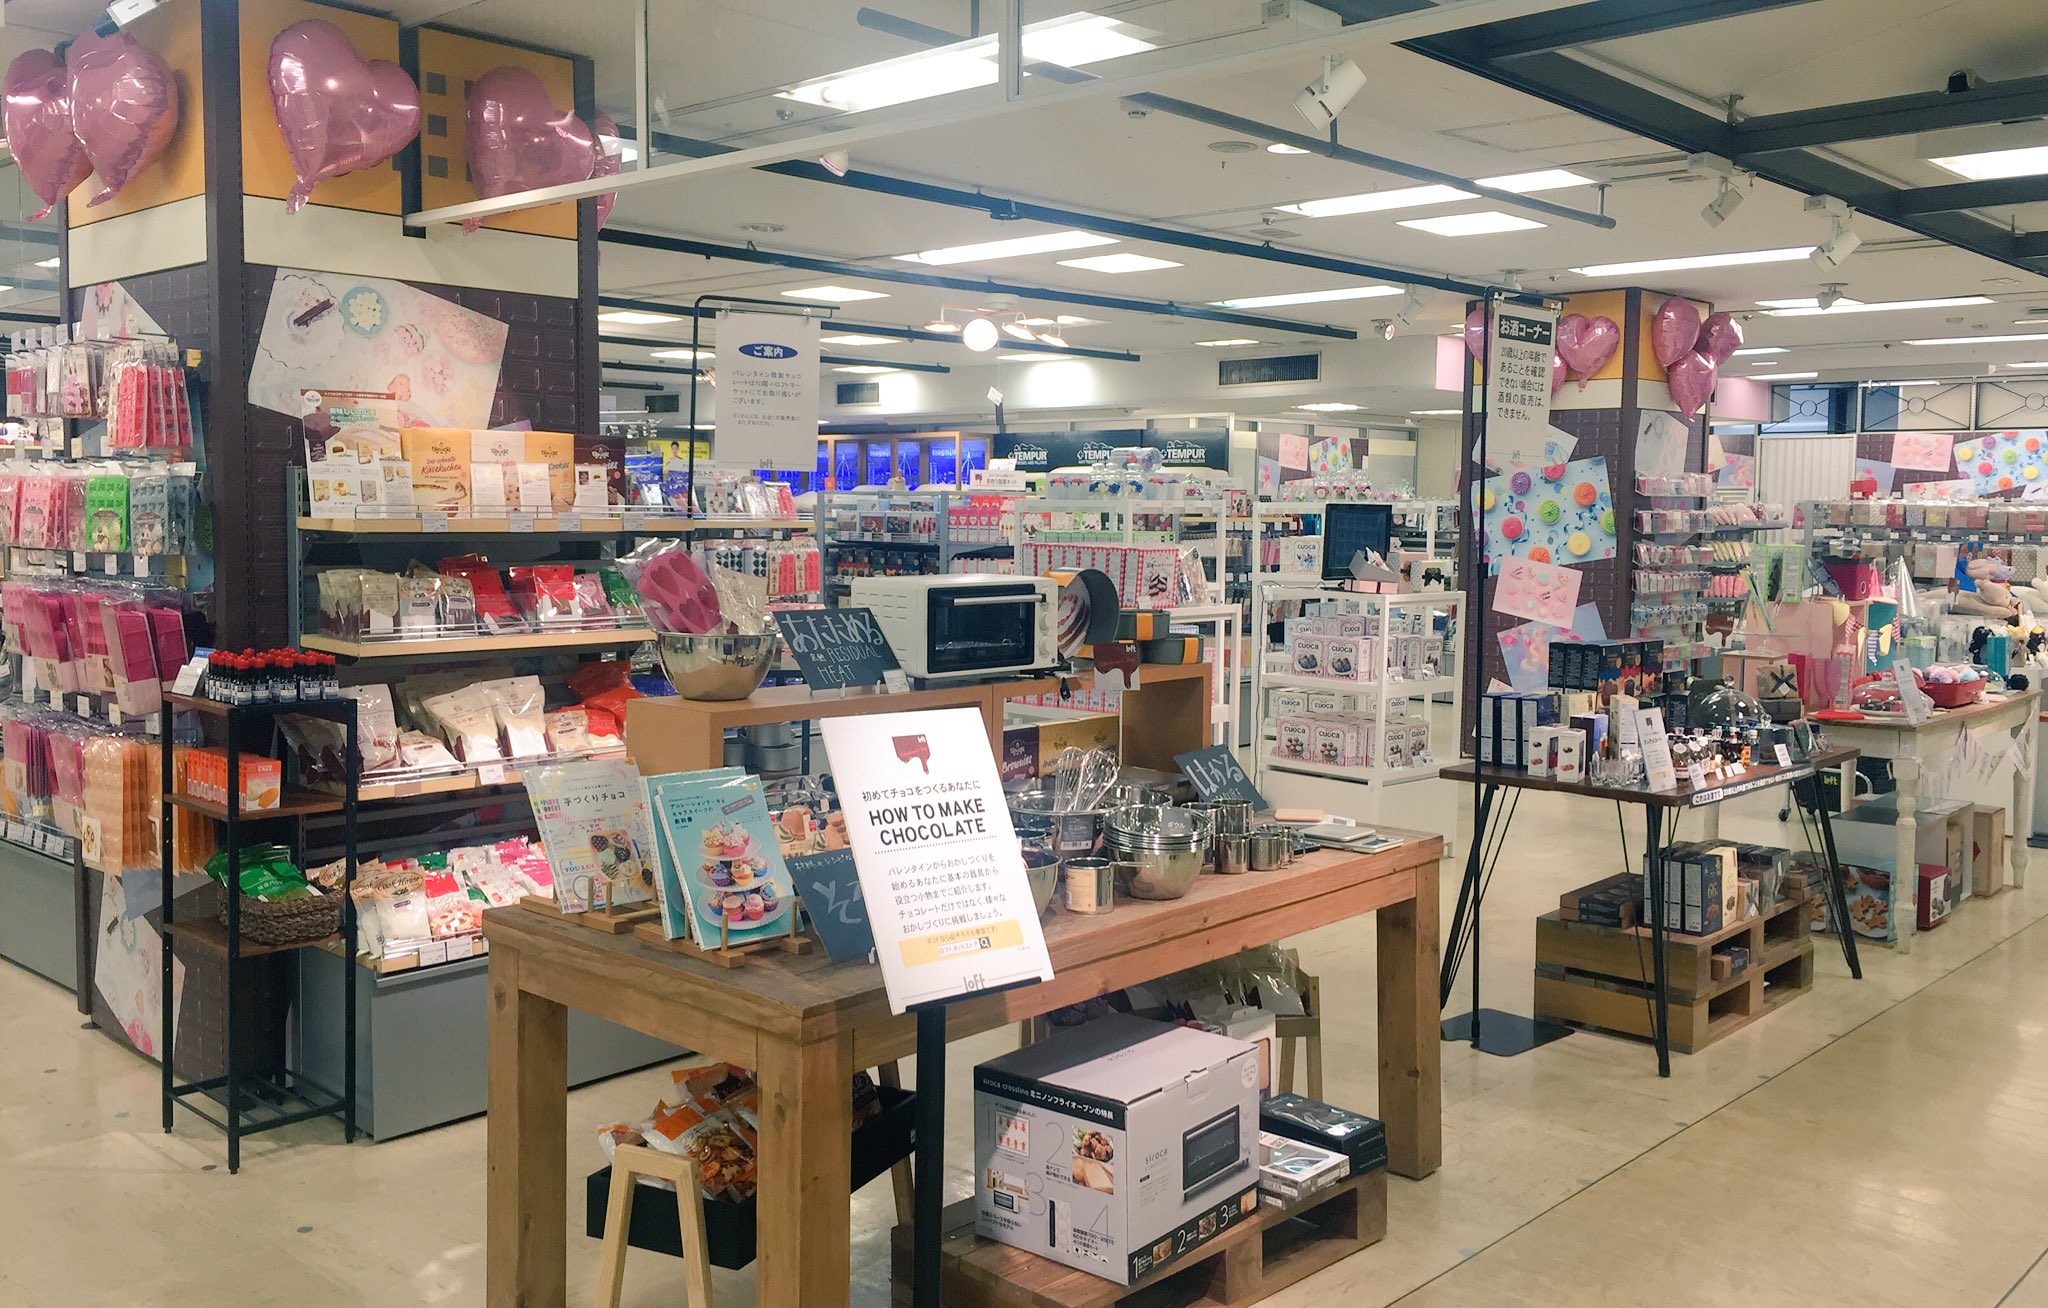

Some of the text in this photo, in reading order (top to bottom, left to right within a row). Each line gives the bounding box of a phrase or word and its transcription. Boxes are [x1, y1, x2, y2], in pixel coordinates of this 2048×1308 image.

[1500, 319, 1550, 340] お酒コーナー
[753, 345, 784, 358] ご案内
[1501, 346, 1547, 363] 20歳以上の年齢で
[1500, 362, 1546, 378] あることを確認
[1499, 377, 1545, 393] できない場合には
[1497, 407, 1530, 421] できません。
[1014, 450, 1048, 461] TEMPUR
[1084, 449, 1112, 461] TEMPU
[1167, 448, 1206, 459] TEMPUR
[1344, 625, 1360, 633] cuoca
[826, 645, 882, 664] RESIDUAL
[1297, 642, 1319, 651] cuoca
[1331, 645, 1353, 653] cuoca
[1426, 644, 1440, 652] cuoca
[817, 664, 856, 685] HEAT
[1284, 726, 1306, 734] cuoca
[1318, 730, 1340, 739] cuoca
[1387, 733, 1404, 742] cuoca
[1411, 729, 1426, 738] cuoca
[1002, 754, 1033, 774] Brownies
[563, 791, 626, 807] 手づくりチョコ
[861, 780, 982, 802] 初めてチョコをつくるあなたに
[868, 797, 986, 827] HOW TO MAKE
[879, 817, 987, 846] CHOCOLATE
[887, 853, 996, 877] バレンタインからおかしづくりを
[890, 866, 1000, 892] 始めるあなたに基本の器具から
[894, 882, 992, 906] 役立つ小物までご紹介します。
[898, 893, 1007, 920] チョコレートだけではなく、様々な
[902, 909, 1004, 934] おかしづくりに挑戦しましょう。
[982, 1078, 1001, 1089] siroca
[1001, 1083, 1029, 1096] crossline
[1029, 1089, 1115, 1121] ミニノンフライオーブンの特長
[1145, 1148, 1168, 1165] siroca
[1220, 1204, 1229, 1229] 3
[1177, 1229, 1187, 1254] 2
[1132, 1256, 1139, 1279] 1
